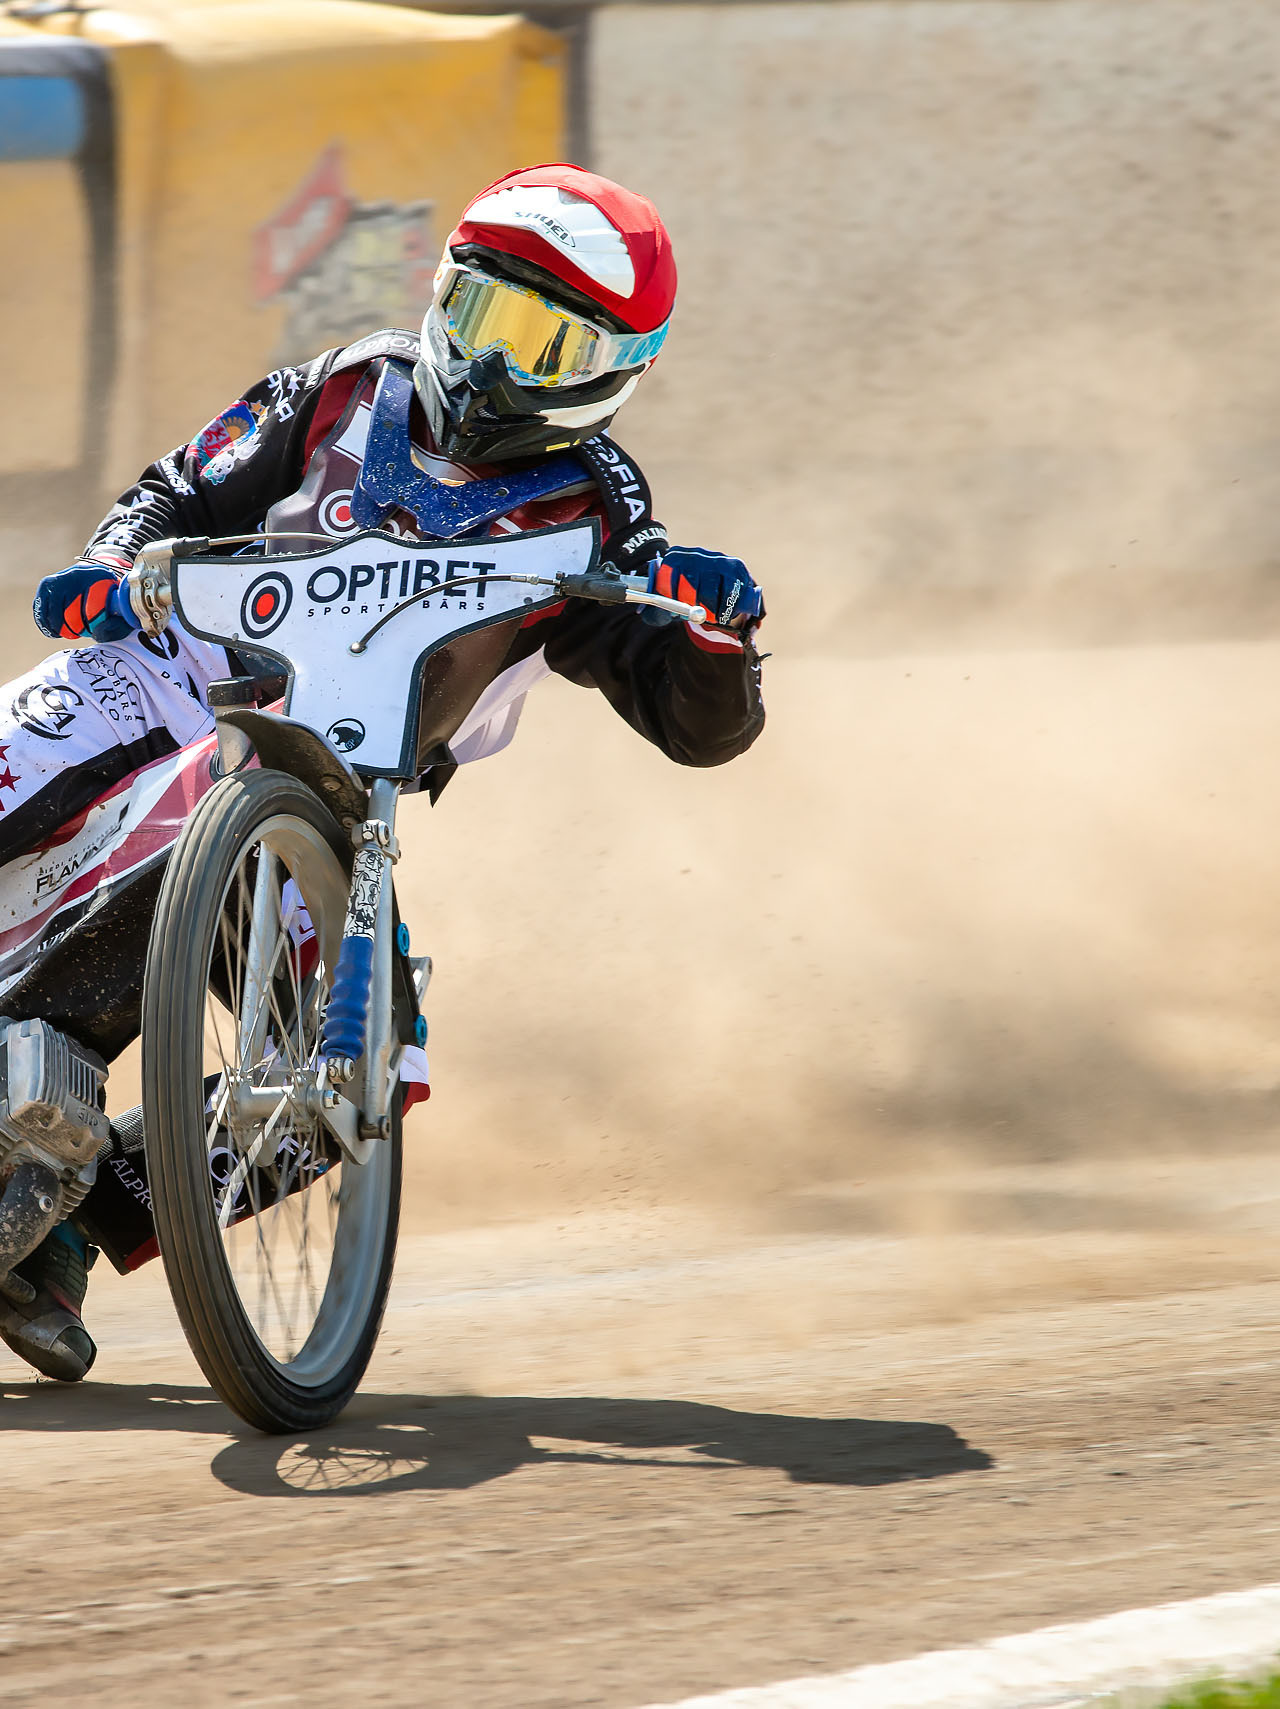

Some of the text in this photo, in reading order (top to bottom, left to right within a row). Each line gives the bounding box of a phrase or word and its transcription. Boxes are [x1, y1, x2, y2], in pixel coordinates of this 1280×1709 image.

[306, 559, 496, 604] OPTIBET
[422, 598, 486, 612] BĀRS
[110, 1157, 154, 1212] ALPR
